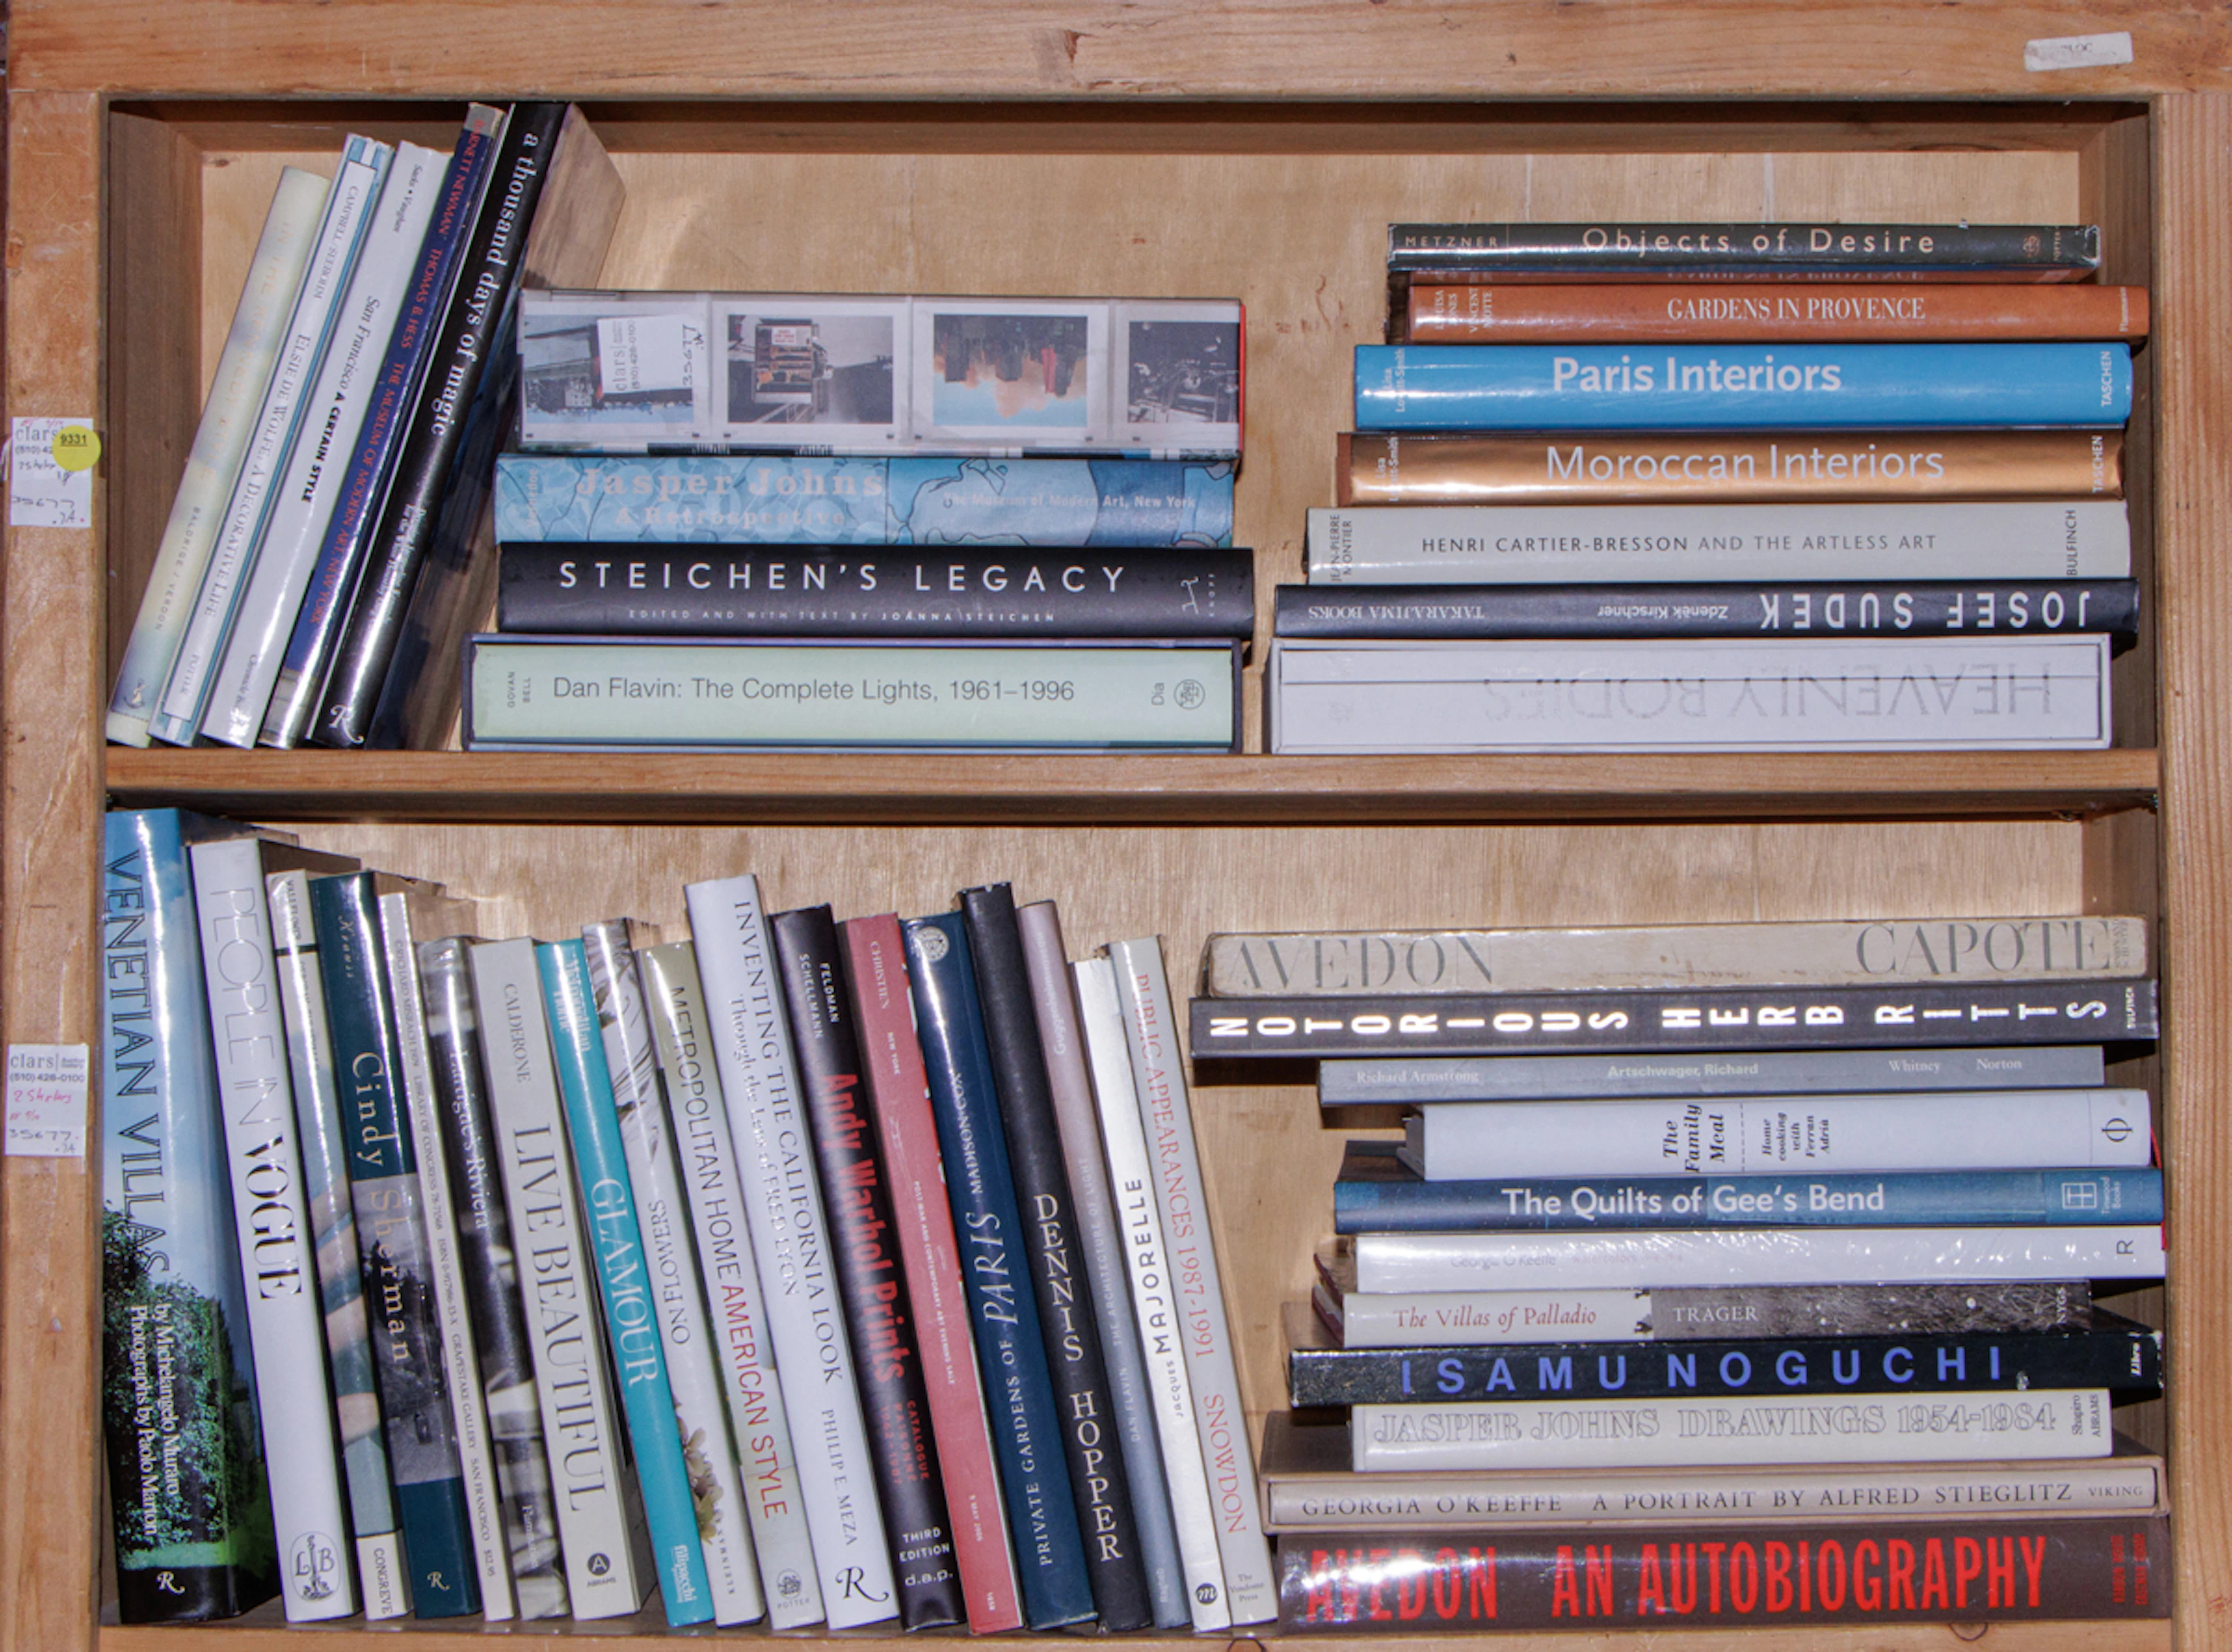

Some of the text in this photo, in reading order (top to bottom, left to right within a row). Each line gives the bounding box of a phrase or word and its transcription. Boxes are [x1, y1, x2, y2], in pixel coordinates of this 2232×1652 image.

[1405, 235, 1498, 248] METZNER
[1583, 228, 1934, 258] Objects of Desire
[414, 246, 443, 305] THOMAS
[423, 131, 539, 439] a thousand days of magic
[1667, 298, 1926, 320] GARDENS IN PROVENCE
[1553, 355, 1842, 392] Paris Interiors
[2101, 350, 2112, 407] TASCHEN
[300, 295, 382, 503] San Francisco CERTAIN STYLE
[60, 434, 87, 445] 9331
[1546, 444, 1944, 481] Moroccan Interiors
[2092, 434, 2104, 493] TASCHEN
[575, 468, 882, 500] Jasper Johns
[1134, 495, 1196, 508] New York
[216, 481, 262, 581] DECORATIVE
[645, 507, 845, 528] Retrospective
[1422, 534, 1937, 553] HENRI CARTIER-BRESSON AND THE ARTLESS ART
[2065, 509, 2076, 576] BULFINCH
[559, 562, 1125, 593] STEICHEN'S LEGACY
[629, 609, 1055, 623] EDITED AND TEXT BY JOANNA STEICHEN
[1308, 606, 1485, 620] TAKARAJIMA BOOKS
[1597, 604, 1668, 619] Kirschner
[1759, 591, 2090, 630] JOSEF SUDEK
[554, 677, 938, 705] Dan Flavin: The Complete Lights,
[1151, 682, 1165, 706] Dia
[1483, 661, 2054, 720] HEAVENLY BODIES
[1226, 920, 2110, 990] AVEDON CAPOTE
[797, 952, 825, 1040] SCHELLMANN
[818, 961, 840, 1024] FELDMAN
[502, 982, 531, 1084] CALDERONE
[1209, 1000, 2108, 1038] NOTORIOUS HERB RITTS
[104, 849, 169, 1274] VENETIAN VILLAS
[1356, 1067, 1480, 1086] Richard Armstrong
[1704, 1063, 1759, 1077] Richard
[1888, 1059, 1941, 1074] Whitney
[1976, 1057, 2023, 1071] Norton
[209, 886, 302, 1300] PEOPLE IN VOGUE
[734, 899, 843, 1383] INVENTING THE CALIFORNIA LOOK
[956, 1116, 983, 1195] MADISON
[1662, 1119, 1679, 1159] The
[1684, 1103, 1703, 1174] Family
[1709, 1114, 1725, 1164] Meal
[1761, 1118, 1772, 1157] Home
[1777, 1112, 1789, 1161] cooking
[345, 1049, 412, 1363] Cindy Sherman
[1501, 1182, 1886, 1222] The Quilts of Bend
[645, 1197, 684, 1304] FLOWERS
[663, 985, 788, 1519] METROPOLITAN HOME AMERICAN STYLE
[819, 1072, 911, 1385] Andy Warhol Prints
[588, 1174, 661, 1389] GLAMOUR
[1124, 1178, 1187, 1419] JACQUES MAJORELLE
[1143, 1063, 1248, 1533] APPEARANCES 1987-1991 SNOWDON
[512, 1122, 608, 1513] LIVE BEAUTIFUL
[1393, 1304, 1597, 1333] The Villas of Palladio
[1672, 1306, 1759, 1322] TRAGER
[126, 1304, 159, 1472] Photographs by Paolo
[964, 1205, 1054, 1567] PRIVATE GARDENS OF PARIS
[1032, 1192, 1124, 1562] DENNIS HOPPER
[1400, 1346, 2002, 1394] ISAMU NOGUCHI
[150, 1302, 185, 1496] by Michelangelo Muraro
[1373, 1402, 2056, 1444] JASPER JOHNS DRAWINGS 1954-1984
[821, 1409, 859, 1546] PHILIP MEZA
[1302, 1483, 2144, 1516] GEORGIA O'KEEFFE A PORTRAIT BY ALFRED STIEGLITZ VIKING
[899, 1542, 950, 1563] EDITION
[902, 1526, 941, 1543] THIRD
[373, 1547, 393, 1615] CONGREVE
[1305, 1535, 2047, 1623] AVEDON AN AUTOBIOGRAPHY
